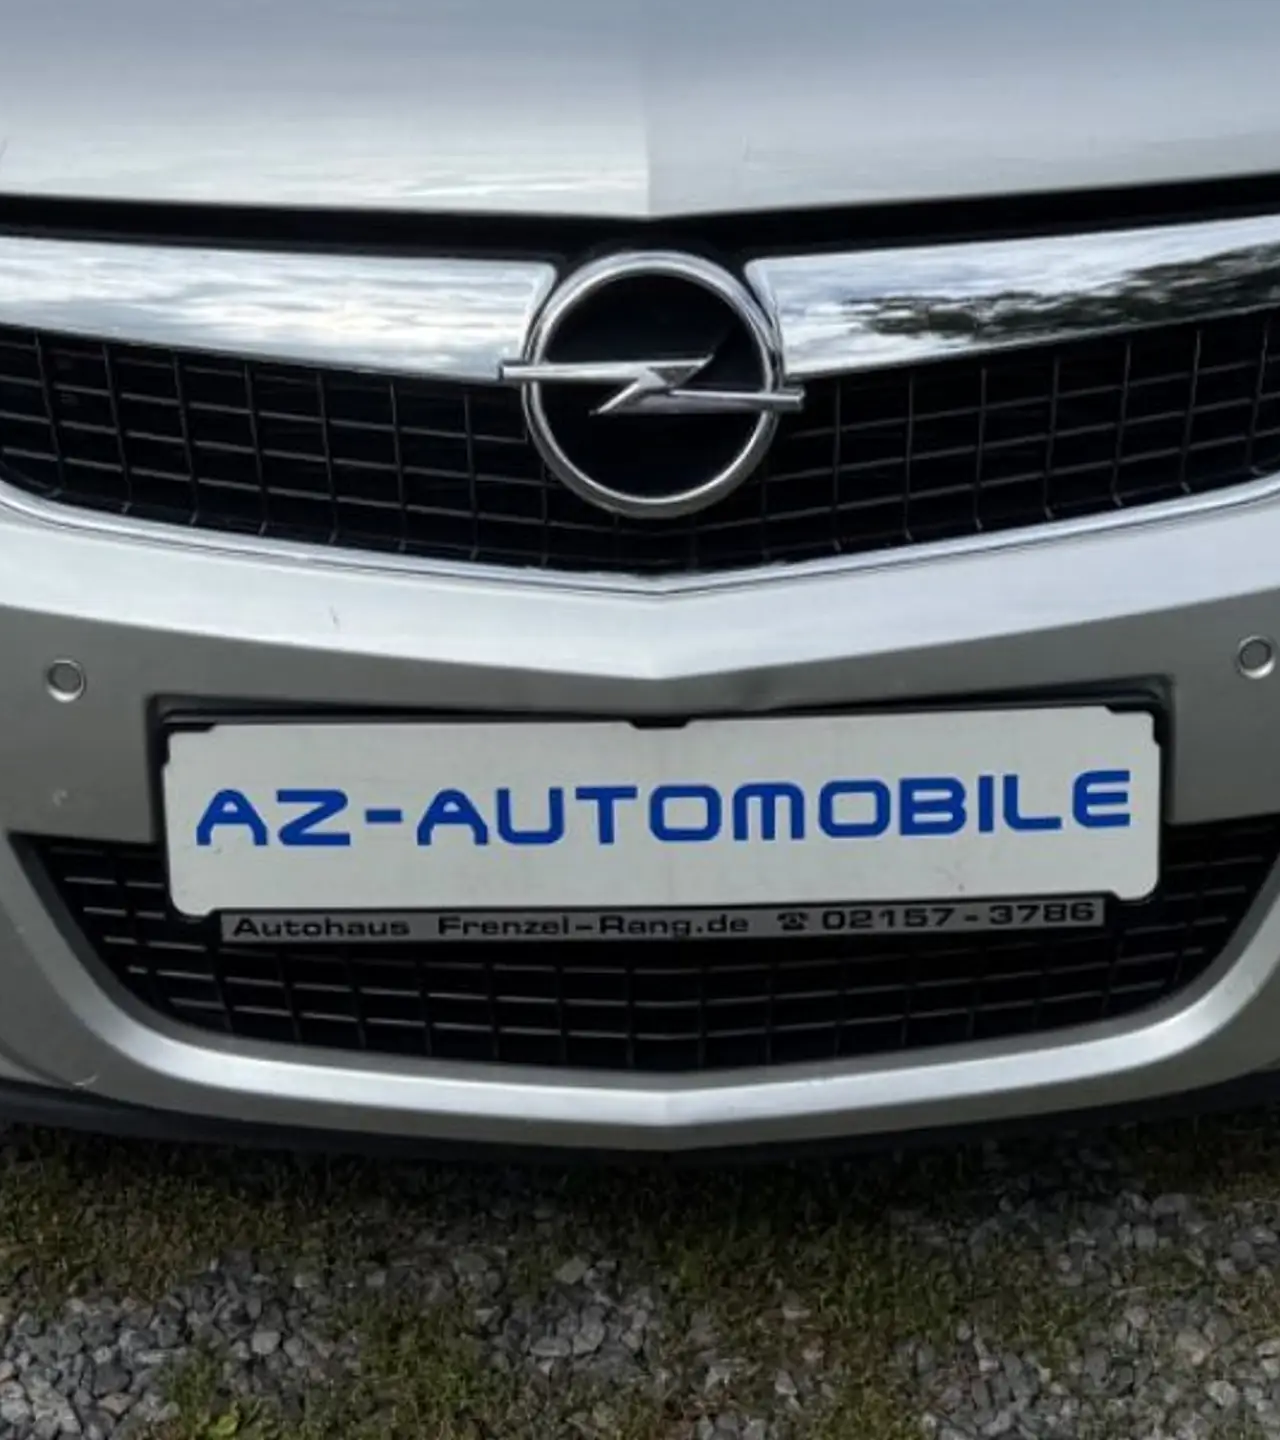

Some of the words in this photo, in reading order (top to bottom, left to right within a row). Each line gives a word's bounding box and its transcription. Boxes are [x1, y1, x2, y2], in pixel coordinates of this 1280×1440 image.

[195, 769, 1131, 848] AZ-AUTOMOBILE
[233, 916, 410, 938] Autohaus
[439, 914, 749, 940] Frenzel-Rang.de
